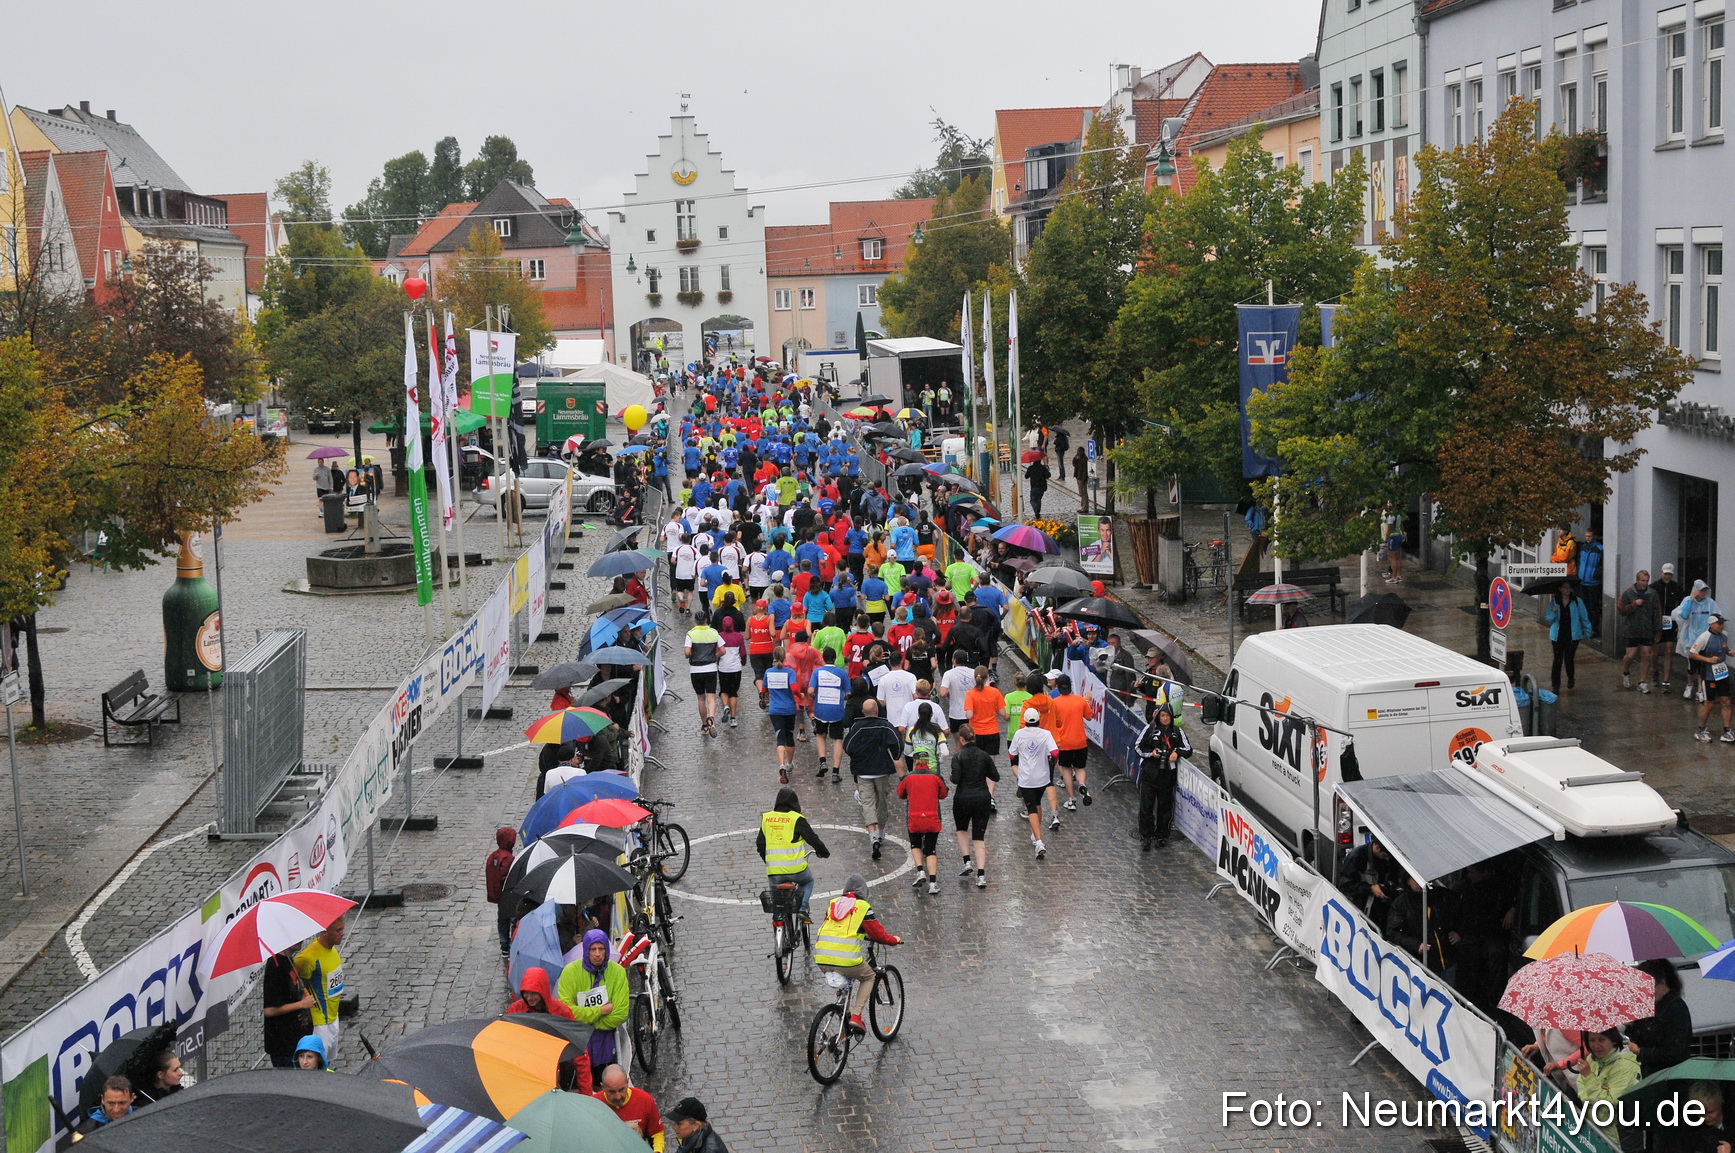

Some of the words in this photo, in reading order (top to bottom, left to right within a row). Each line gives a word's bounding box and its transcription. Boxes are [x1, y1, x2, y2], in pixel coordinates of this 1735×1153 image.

[1508, 565, 1566, 576] Brunnwirtsgasse
[898, 635, 913, 652] 10
[1456, 729, 1476, 741] Schnell
[1272, 760, 1282, 773] rent
[1287, 770, 1301, 787] truck
[1321, 898, 1452, 1066] BOCK
[585, 994, 603, 1007] 498
[52, 939, 203, 1134] BOCK
